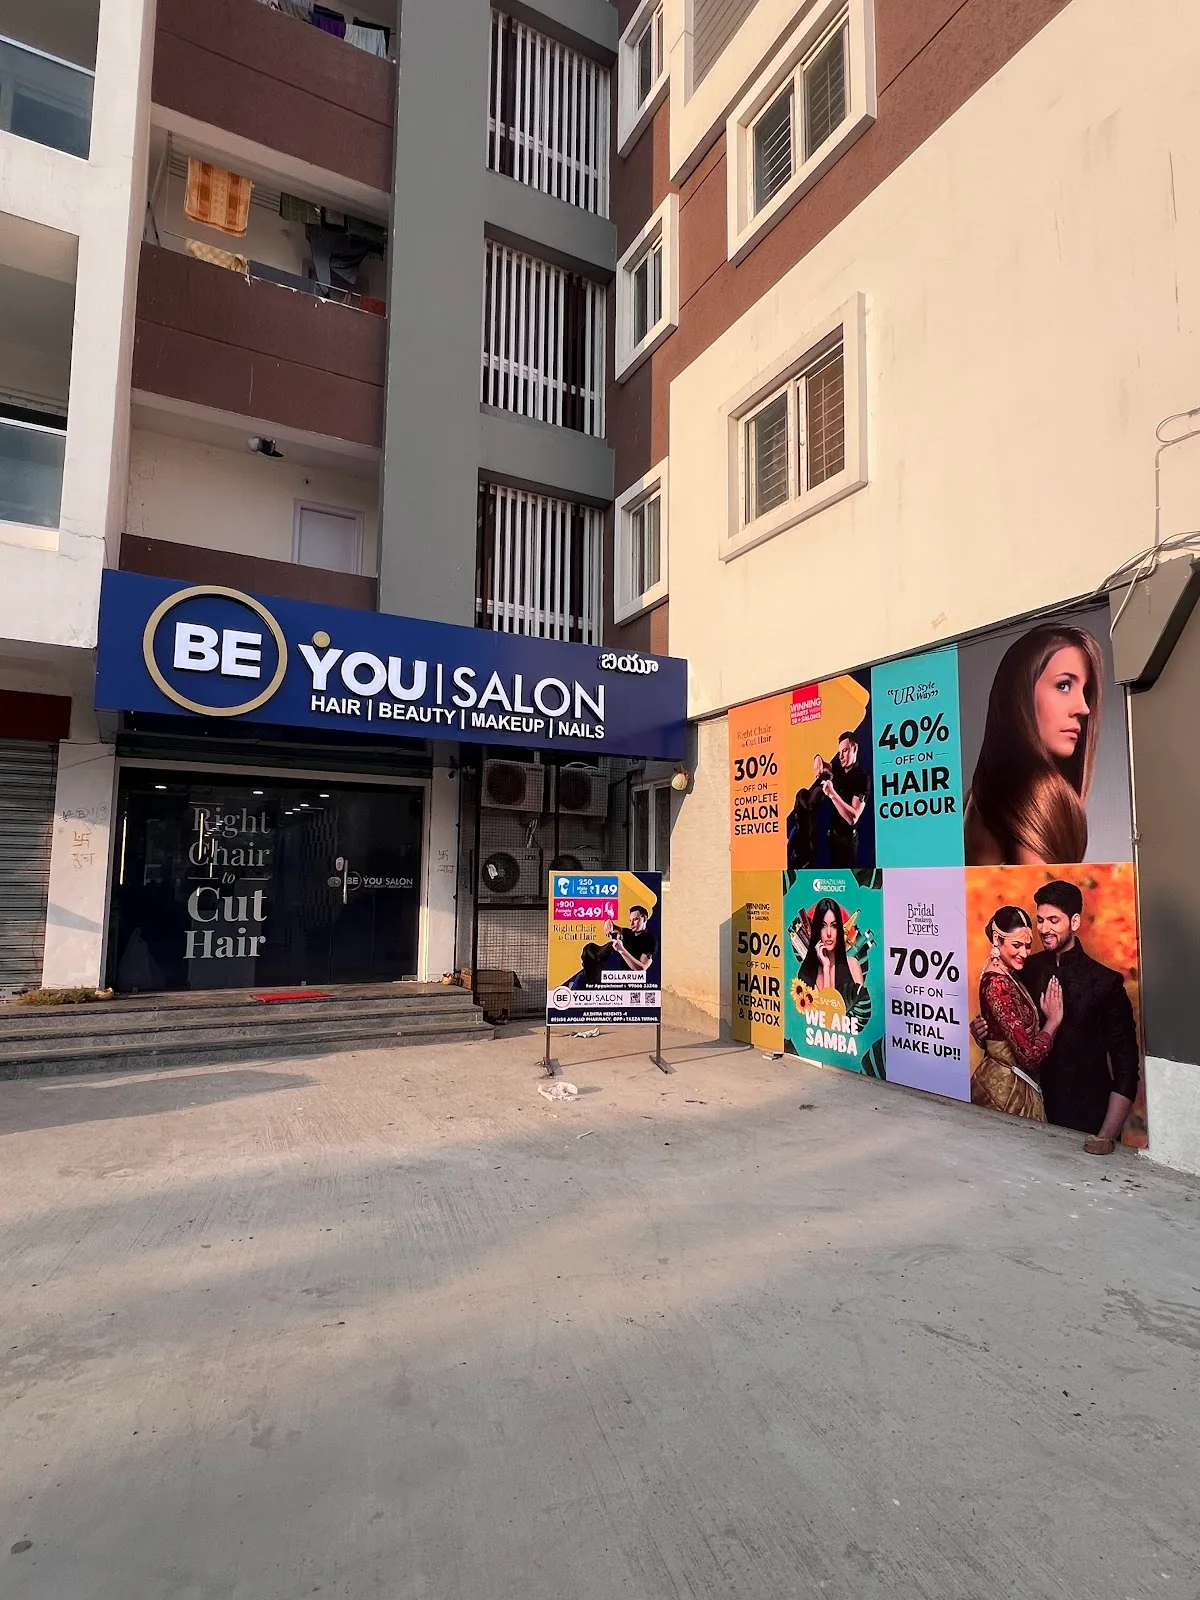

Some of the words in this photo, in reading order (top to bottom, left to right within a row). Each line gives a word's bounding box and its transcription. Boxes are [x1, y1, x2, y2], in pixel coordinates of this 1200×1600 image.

[173, 621, 262, 678] BE
[298, 643, 427, 700] YOU
[452, 665, 605, 722] SALON
[918, 681, 935, 692] Style
[790, 697, 821, 712] WINNING
[311, 694, 361, 715] HAIR
[378, 703, 457, 726] BEAUTY
[470, 712, 545, 734] MAKEUP
[557, 719, 605, 739] NAILS
[791, 710, 808, 718] HEARTS
[737, 730, 752, 740] Right
[754, 724, 772, 736] Chair
[746, 738, 757, 746] Cut
[758, 734, 772, 744] Hair
[878, 712, 949, 750] 40%
[733, 752, 778, 781] 30%
[895, 754, 916, 766] OFF
[918, 752, 933, 763] ON
[743, 784, 756, 792] OFF
[758, 782, 768, 792] ON
[882, 766, 950, 797] HAIR
[734, 792, 778, 806] COMPLETE
[879, 796, 956, 819] COLOUR
[192, 806, 270, 838] Right
[734, 804, 778, 822] SALON
[734, 822, 778, 836] SERVICE
[189, 842, 270, 867] Chair
[222, 871, 236, 884] to
[386, 878, 413, 886] SALON
[188, 887, 268, 922] Cut
[908, 904, 934, 918] Bridal
[554, 924, 574, 934] Right
[576, 924, 596, 932] Chair
[908, 920, 938, 936] Experts
[183, 927, 266, 959] Hair
[738, 932, 780, 958] 50%
[746, 960, 759, 970] OFF
[760, 962, 770, 971] ON
[890, 947, 960, 982] 70%
[738, 972, 780, 997] HAIR
[905, 984, 925, 996] OFF
[928, 987, 943, 998] ON
[596, 994, 623, 1002] SALON
[738, 994, 780, 1012] KERATIN
[738, 1009, 745, 1019] &
[748, 1010, 780, 1027] BOTOX
[892, 999, 960, 1025] BRIDAL
[805, 1008, 826, 1026] WE
[831, 1014, 859, 1035] ARE
[906, 1022, 944, 1040] TRIAL
[806, 1028, 858, 1056] SAMBA
[892, 1038, 929, 1054] MAKE
[933, 1044, 961, 1061] UP!!
